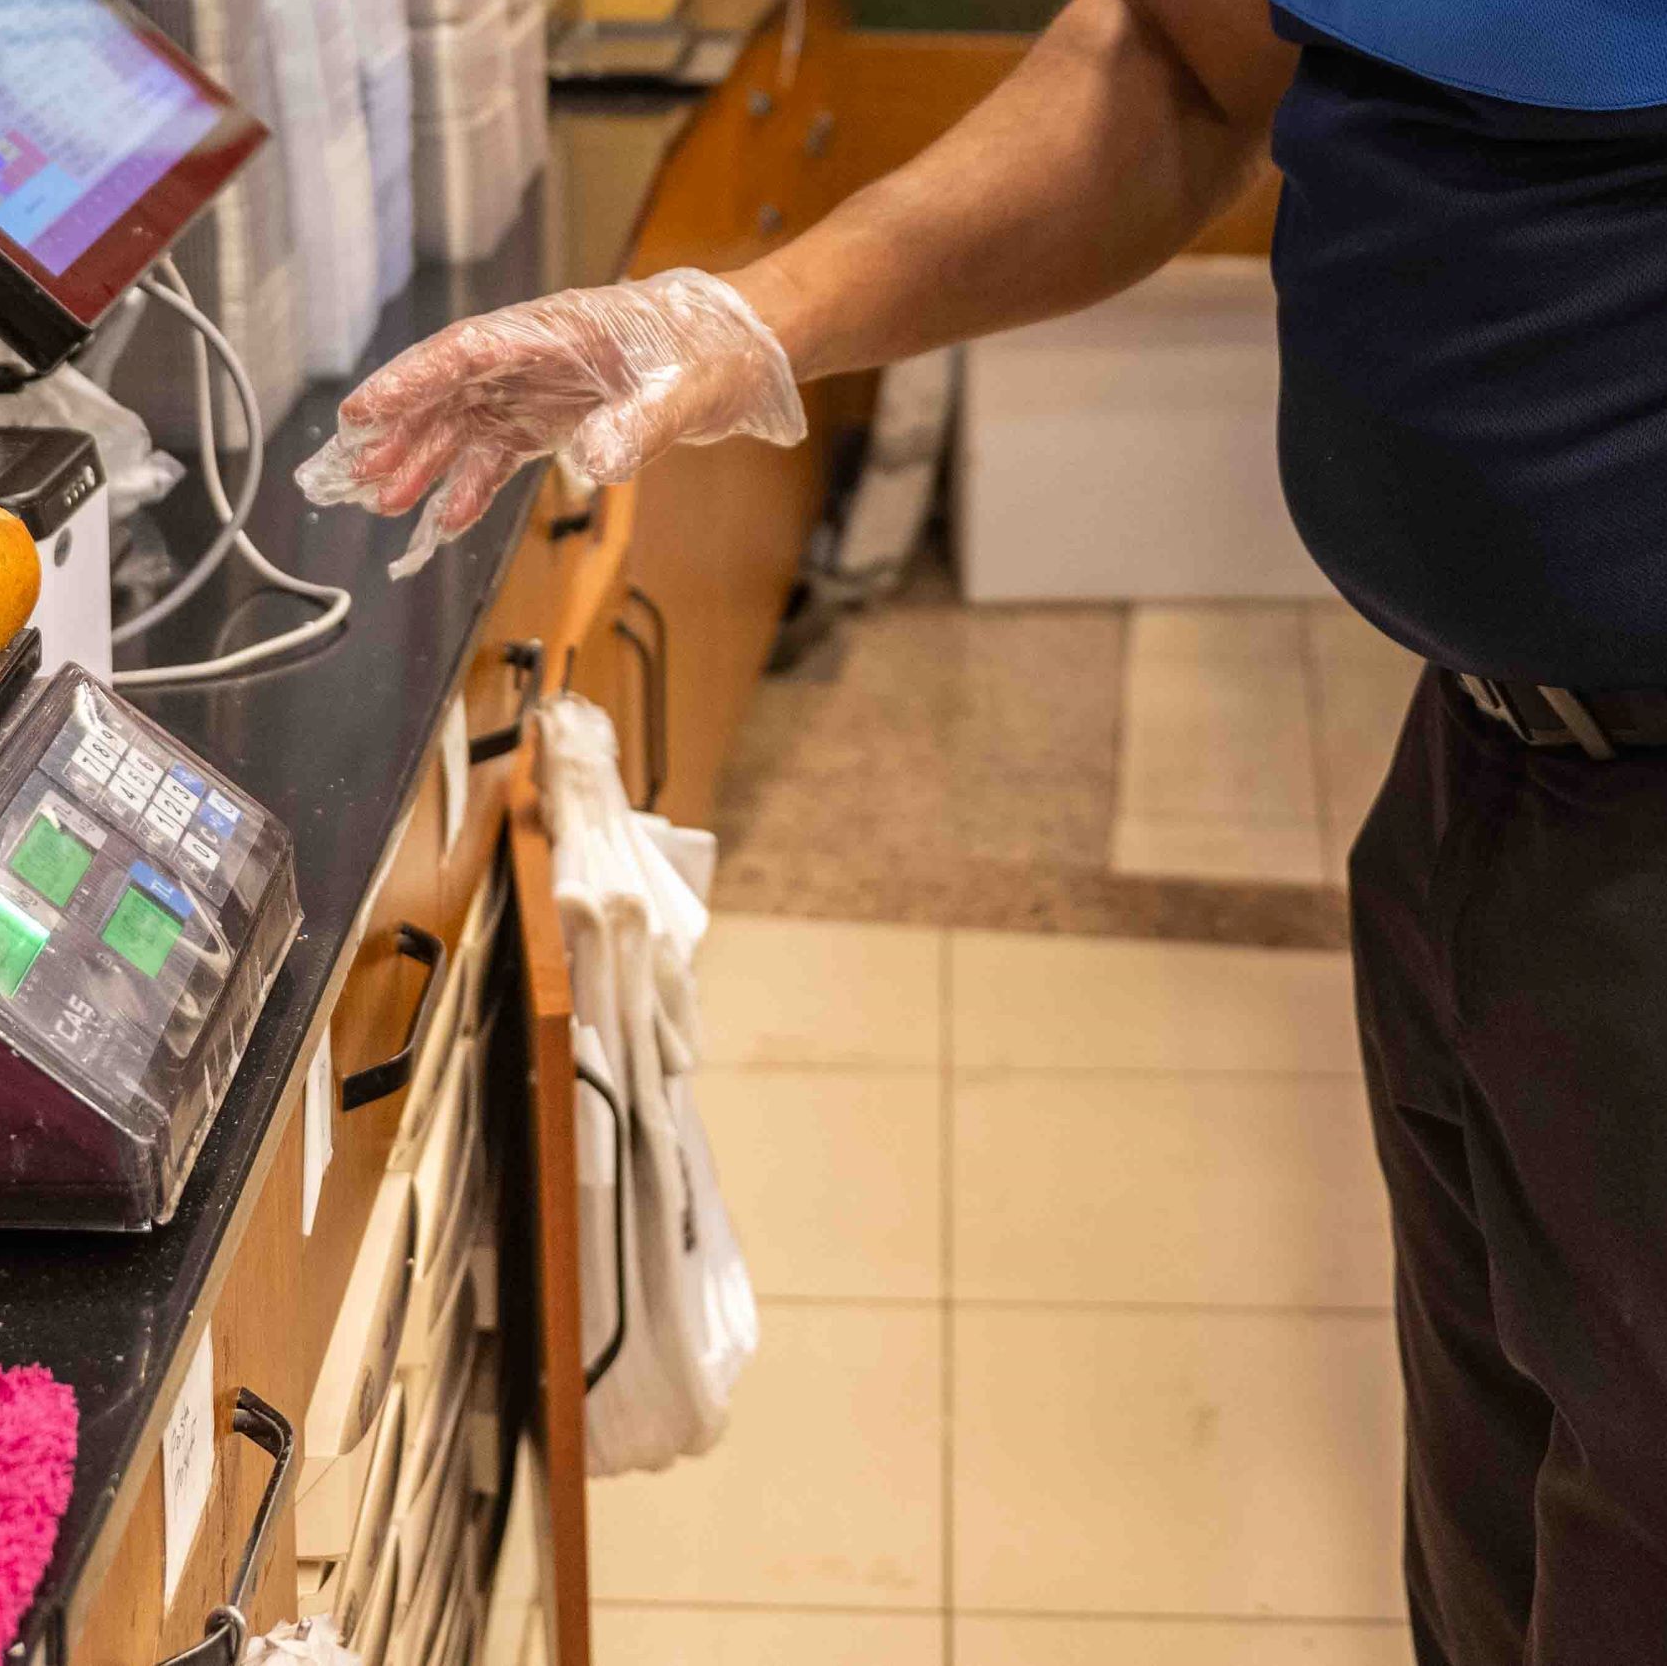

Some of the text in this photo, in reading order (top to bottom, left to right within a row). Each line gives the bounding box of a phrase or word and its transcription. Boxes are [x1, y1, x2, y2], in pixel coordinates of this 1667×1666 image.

[82, 756, 101, 773] 7
[92, 742, 111, 758] 8
[136, 757, 154, 772] 6
[127, 771, 146, 787] 5
[120, 786, 137, 801] 4
[157, 785, 191, 830] 1 2 3
[192, 843, 211, 859] 0
[150, 879, 174, 900] TL
[54, 992, 97, 1044] CAS
